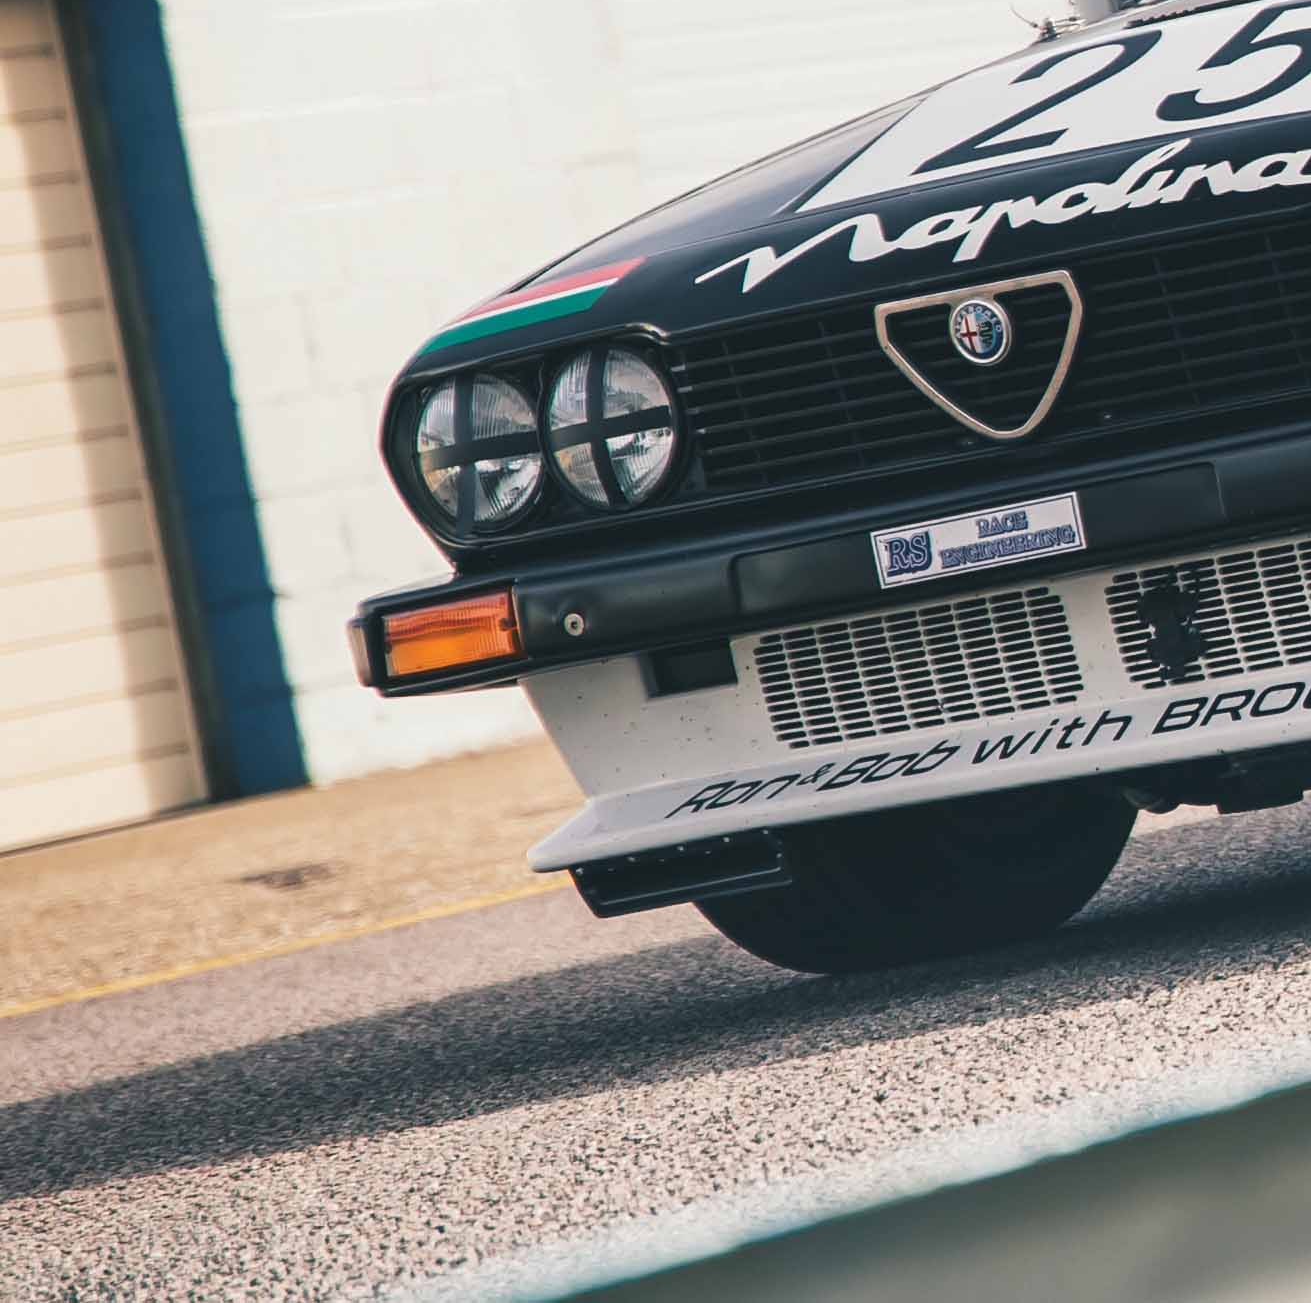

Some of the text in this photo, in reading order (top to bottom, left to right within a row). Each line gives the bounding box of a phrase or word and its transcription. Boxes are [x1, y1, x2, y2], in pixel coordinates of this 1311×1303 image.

[939, 524, 1076, 569] ENGINEERING
[976, 510, 1029, 539] RACE
[879, 531, 934, 578] RS
[971, 708, 1133, 766] with
